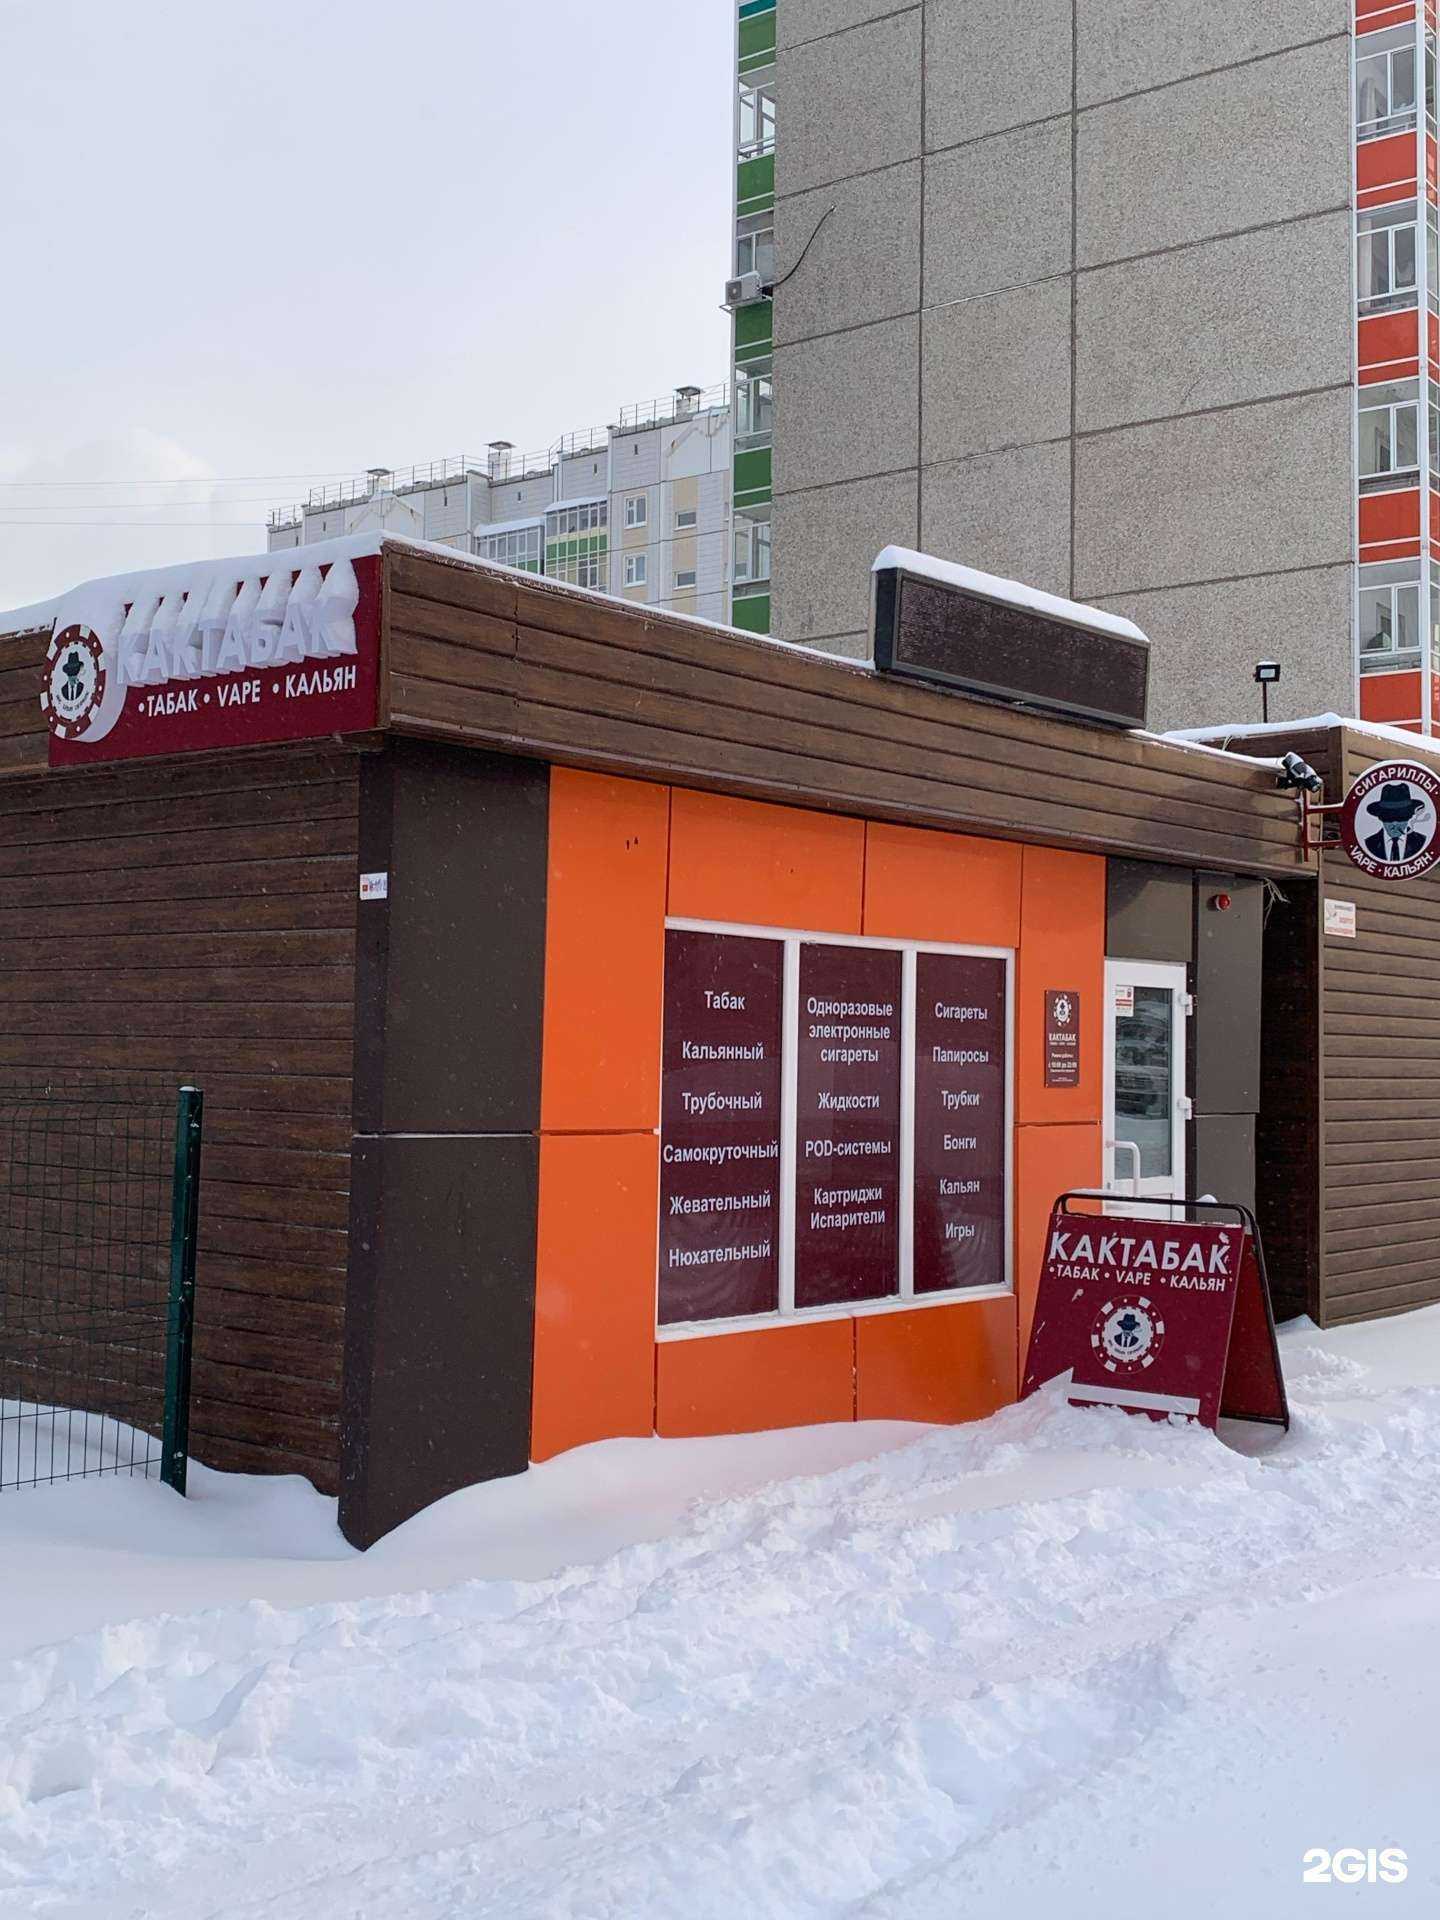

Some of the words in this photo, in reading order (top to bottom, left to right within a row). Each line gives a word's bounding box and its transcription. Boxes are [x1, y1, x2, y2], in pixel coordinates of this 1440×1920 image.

[117, 599, 357, 687] КАКТАБАК
[147, 689, 199, 717] ТАБАК
[217, 680, 261, 707] VAPE
[285, 665, 357, 698] КАЛЬЯН
[1354, 767, 1438, 796] СИГАРИЛЛЫ
[1350, 846, 1377, 873] VAPE
[1383, 851, 1434, 877] КАЛЬЯН
[704, 991, 745, 1010] Табак
[807, 997, 893, 1018] Одноразовые
[935, 1002, 988, 1021] Сигареты
[809, 1021, 890, 1042] электронные
[682, 1041, 764, 1060] Кальянный
[821, 1047, 878, 1064] сигареты
[933, 1047, 988, 1065] Папиросы
[682, 1092, 762, 1113] Трубочный
[818, 1092, 879, 1111] Жидкости
[942, 1090, 980, 1107] Трубки
[806, 1139, 891, 1157] POD-системы
[944, 1135, 976, 1150] Бонги
[663, 1142, 779, 1164] Самокруточный
[814, 1187, 882, 1207] Картриджи
[940, 1179, 980, 1195] Кальян
[670, 1191, 770, 1214] Жевательный
[811, 1209, 885, 1229] Испарители
[946, 1223, 975, 1240] Игры
[669, 1241, 770, 1267] Нюхательный
[1048, 1231, 1231, 1274] КАКТАБАК
[1057, 1264, 1100, 1281] ТАБАК
[1115, 1270, 1151, 1285] VAPE
[1170, 1275, 1226, 1291] КАЛЬЯН
